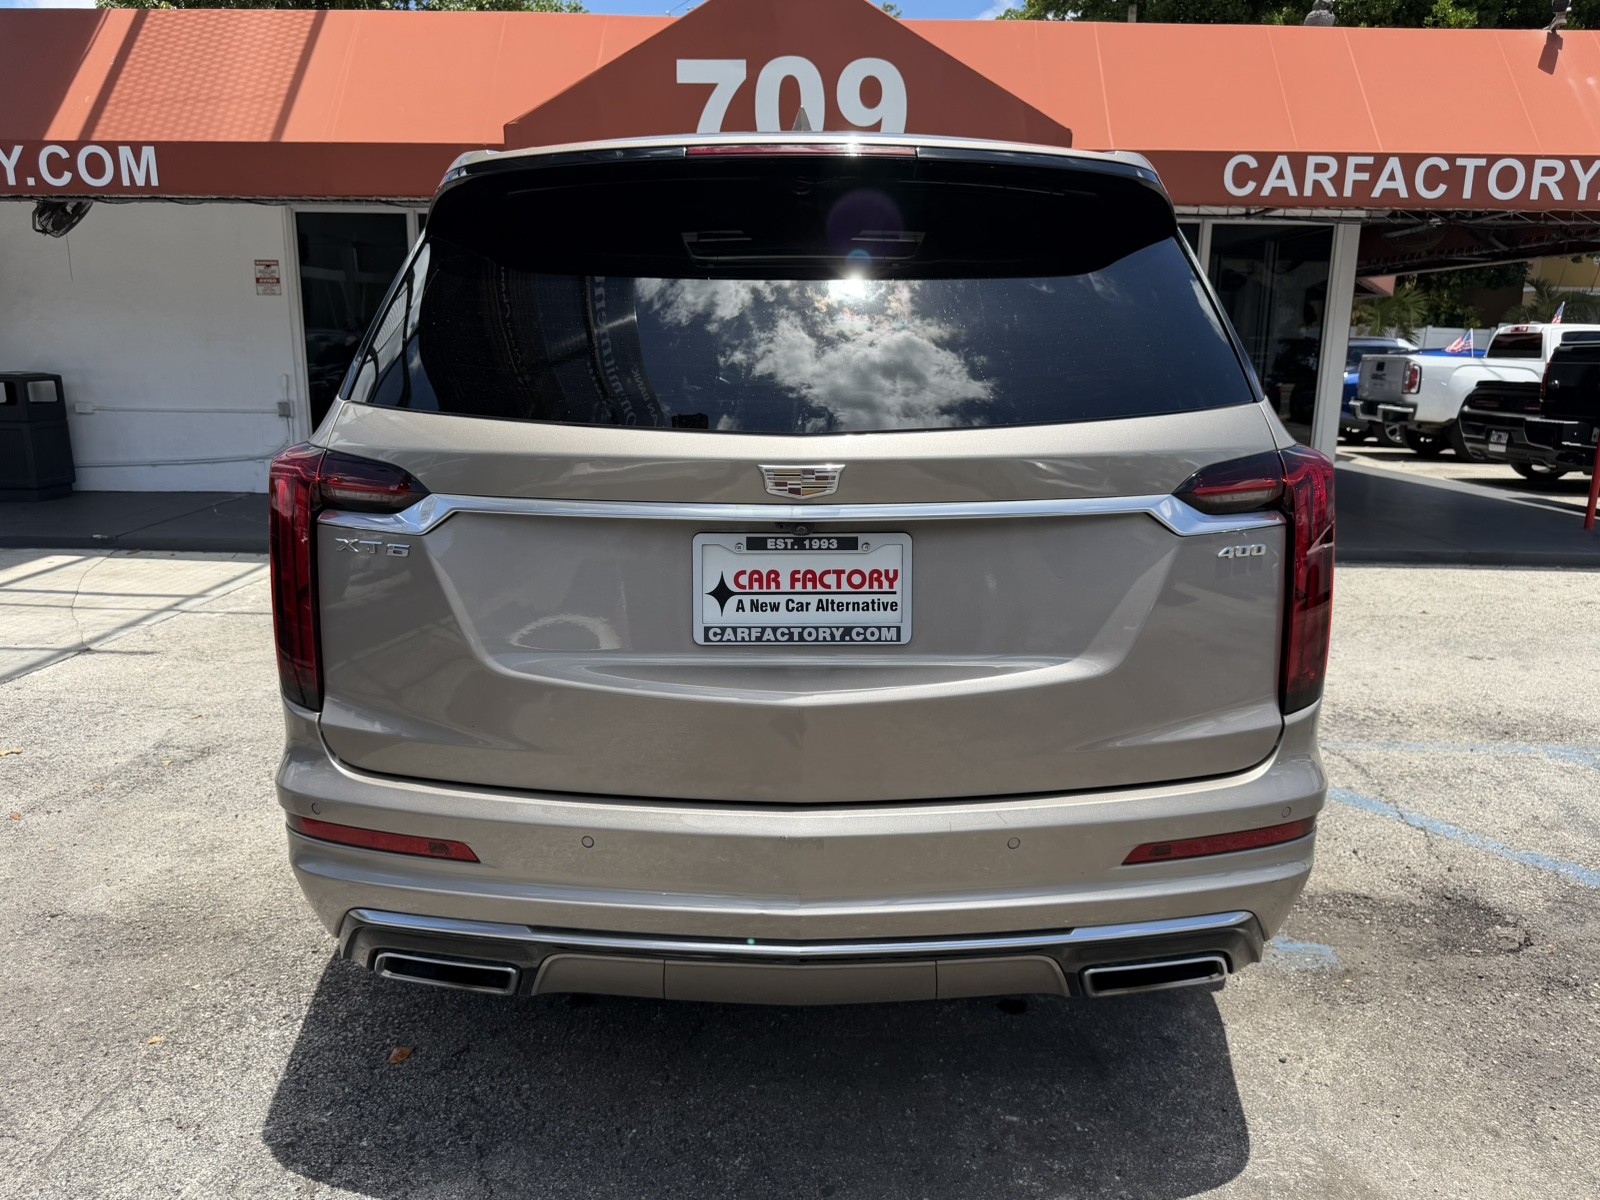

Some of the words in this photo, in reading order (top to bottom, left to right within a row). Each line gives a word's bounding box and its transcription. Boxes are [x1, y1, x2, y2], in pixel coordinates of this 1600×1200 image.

[676, 55, 907, 134] 709
[0, 145, 159, 187] Y.COM
[335, 537, 411, 557] XT6
[766, 538, 798, 549] EST.
[803, 538, 838, 549] 1993
[1217, 544, 1266, 558] 400
[733, 569, 781, 590] CAR
[789, 568, 899, 590] FACTORY
[735, 599, 746, 613] A
[750, 599, 781, 613] New
[785, 599, 811, 613] Car
[815, 598, 899, 613] Alternative
[708, 627, 897, 642] CARFACTORY.COM
